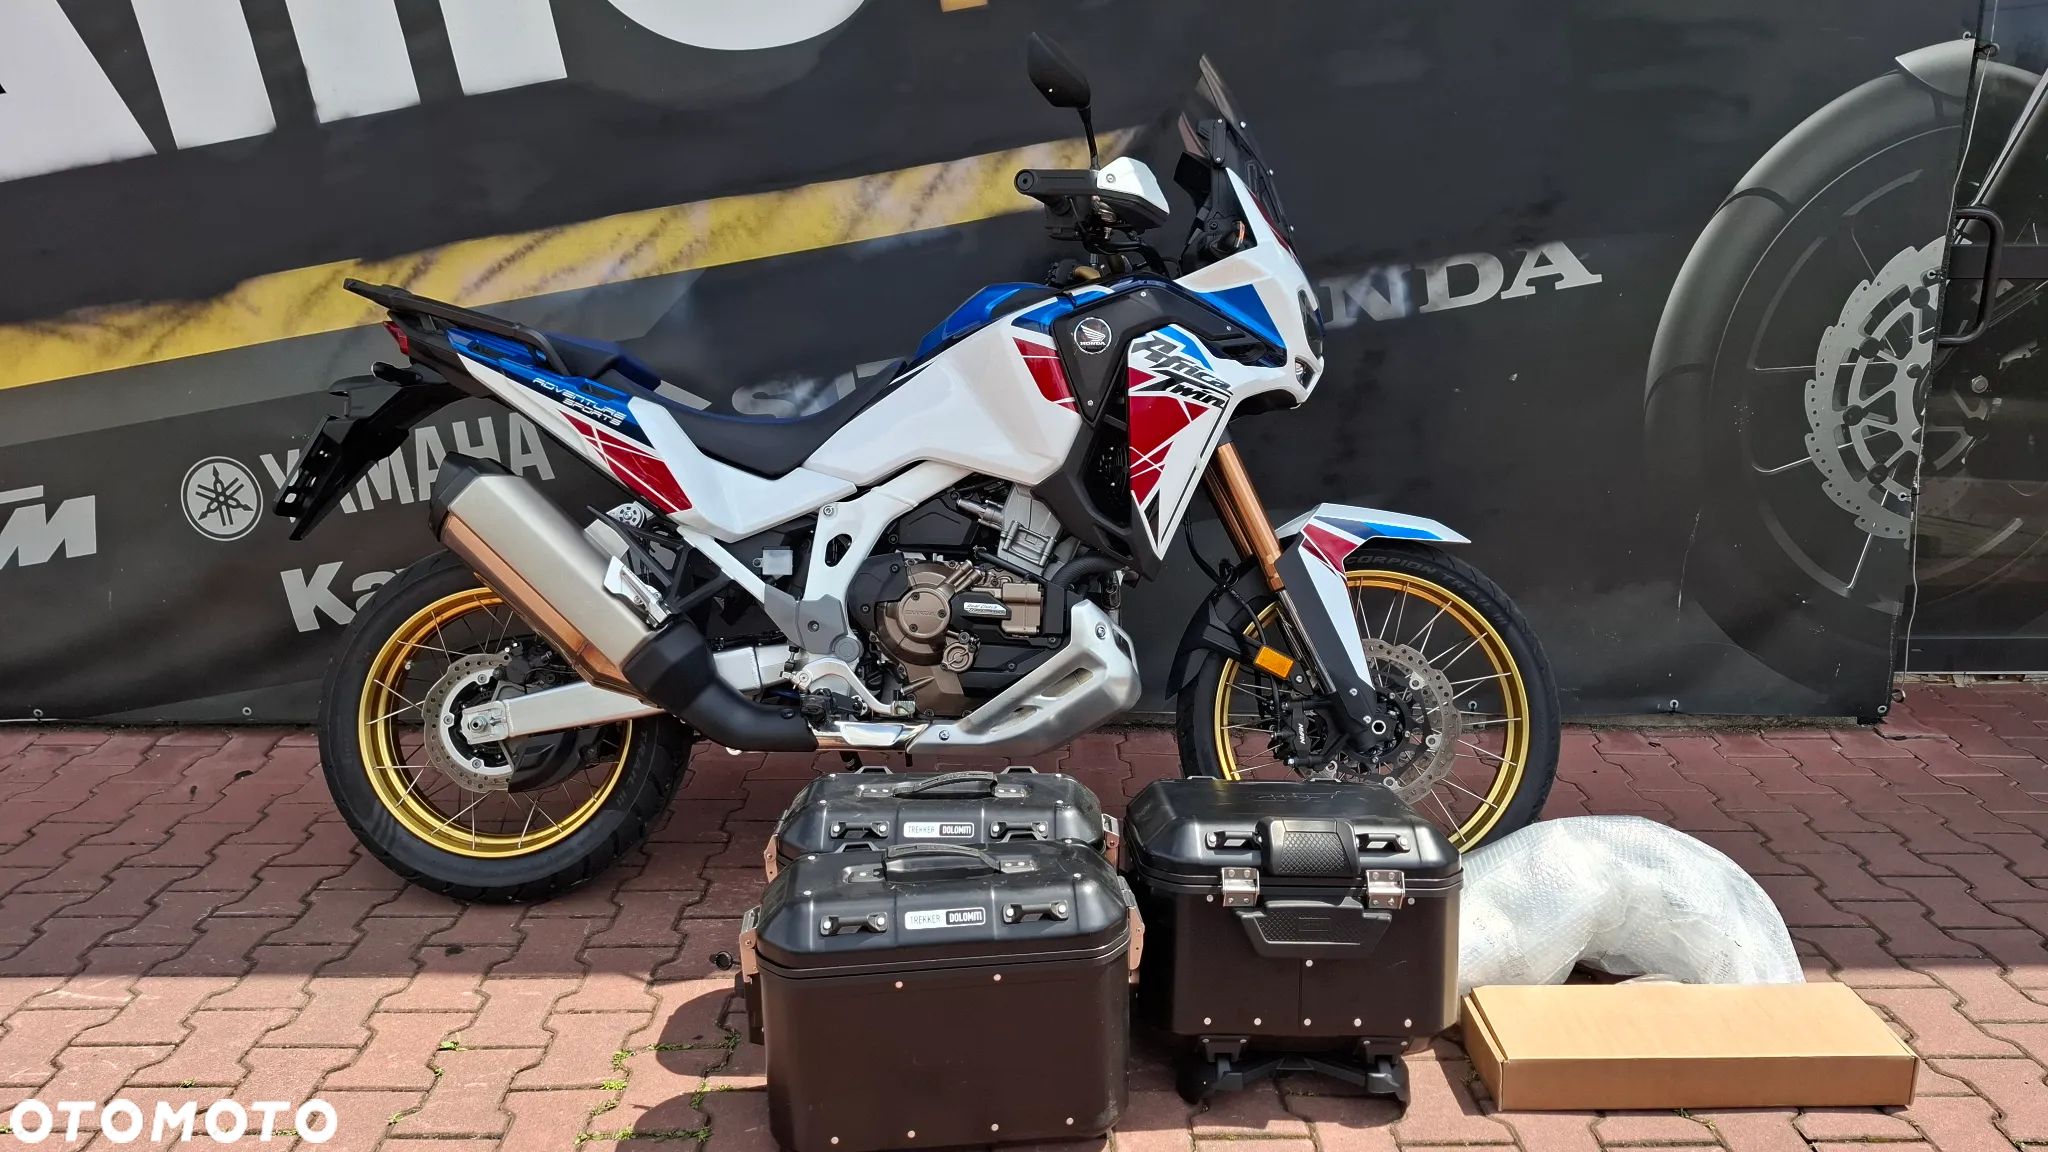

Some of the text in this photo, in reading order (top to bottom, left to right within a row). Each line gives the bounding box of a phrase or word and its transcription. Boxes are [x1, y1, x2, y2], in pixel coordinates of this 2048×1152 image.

[1130, 333, 1232, 390] Africa
[532, 377, 627, 420] ADVENTURE
[1133, 369, 1234, 408] Twin
[562, 398, 622, 427] SPORTS
[259, 411, 556, 524] YMAHA
[908, 824, 935, 834] TREKKER
[910, 910, 983, 925] TREKKER DOLOMITI
